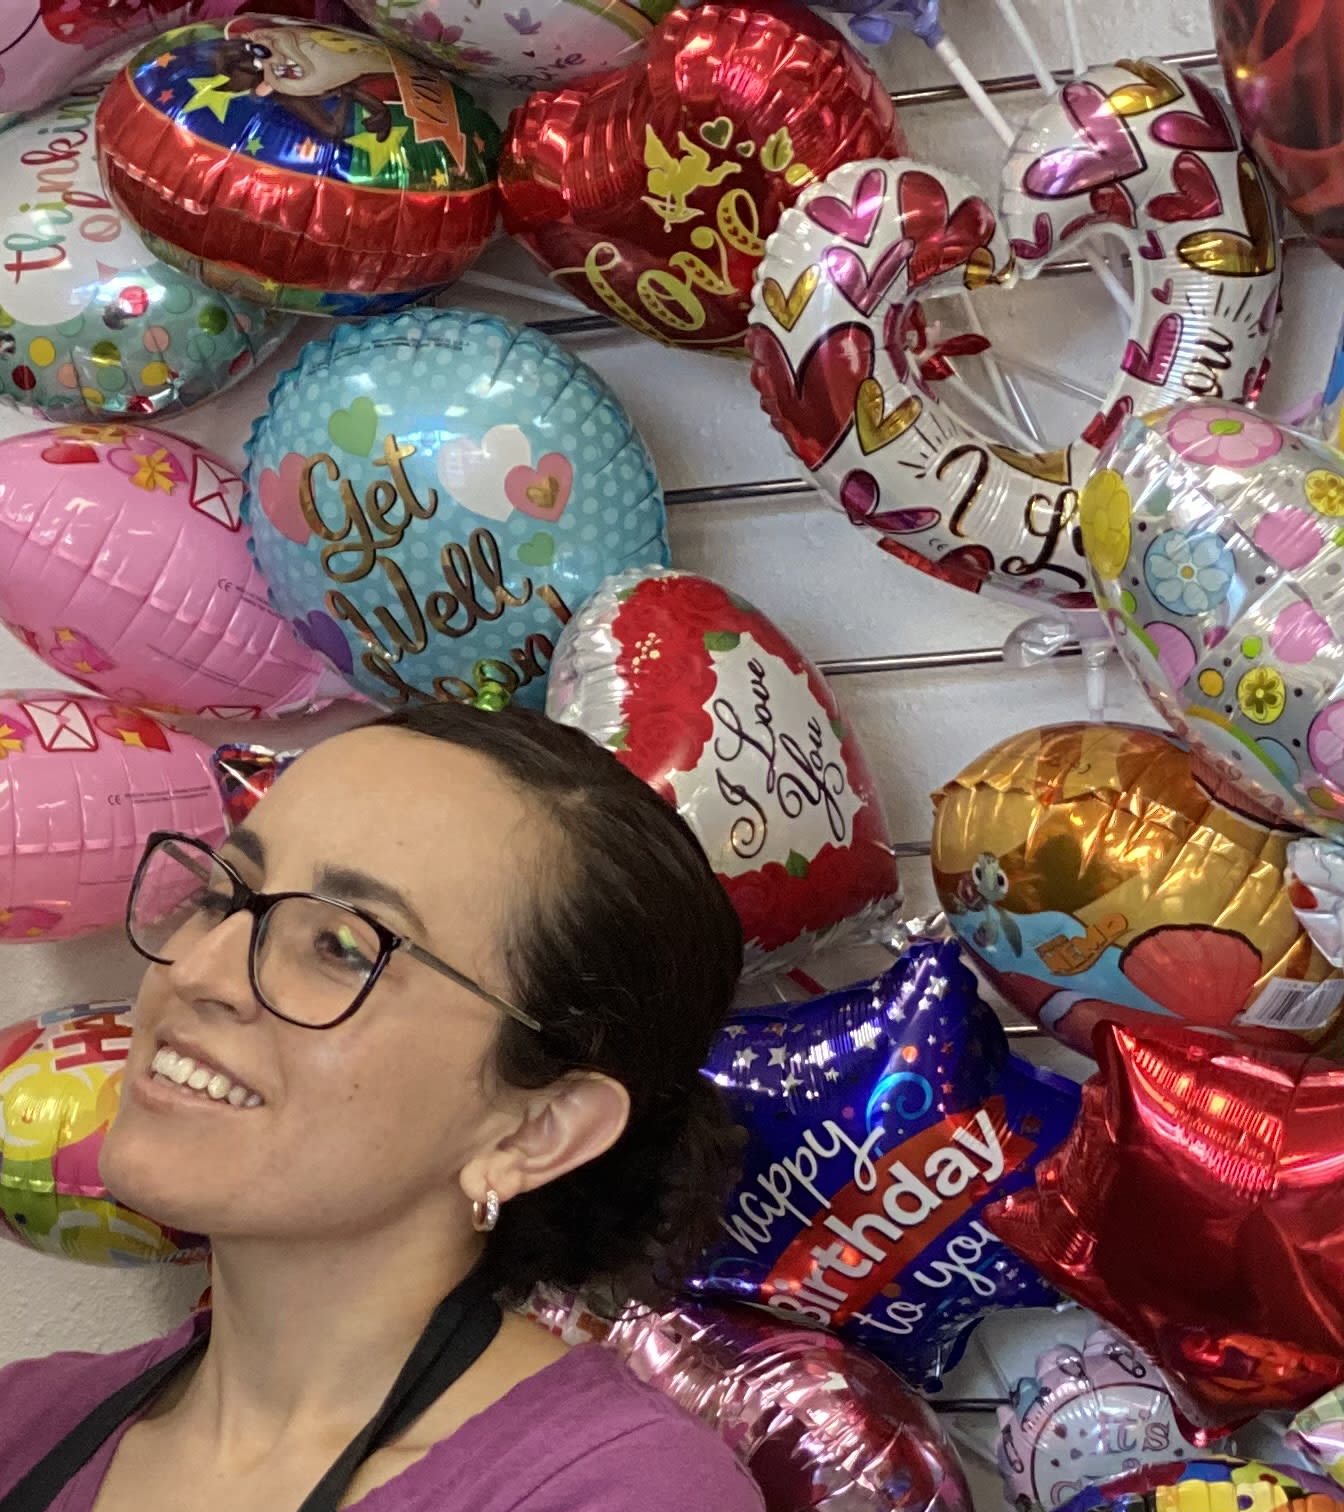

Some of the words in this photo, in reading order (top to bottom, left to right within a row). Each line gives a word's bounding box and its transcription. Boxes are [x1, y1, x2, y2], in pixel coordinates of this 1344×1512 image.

[1181, 327, 1234, 400] ou
[299, 433, 438, 582] Get
[324, 527, 532, 662] Well
[712, 657, 776, 794] Love
[776, 716, 846, 842] You
[767, 1108, 1005, 1326] Birthday
[850, 1299, 927, 1335] to
